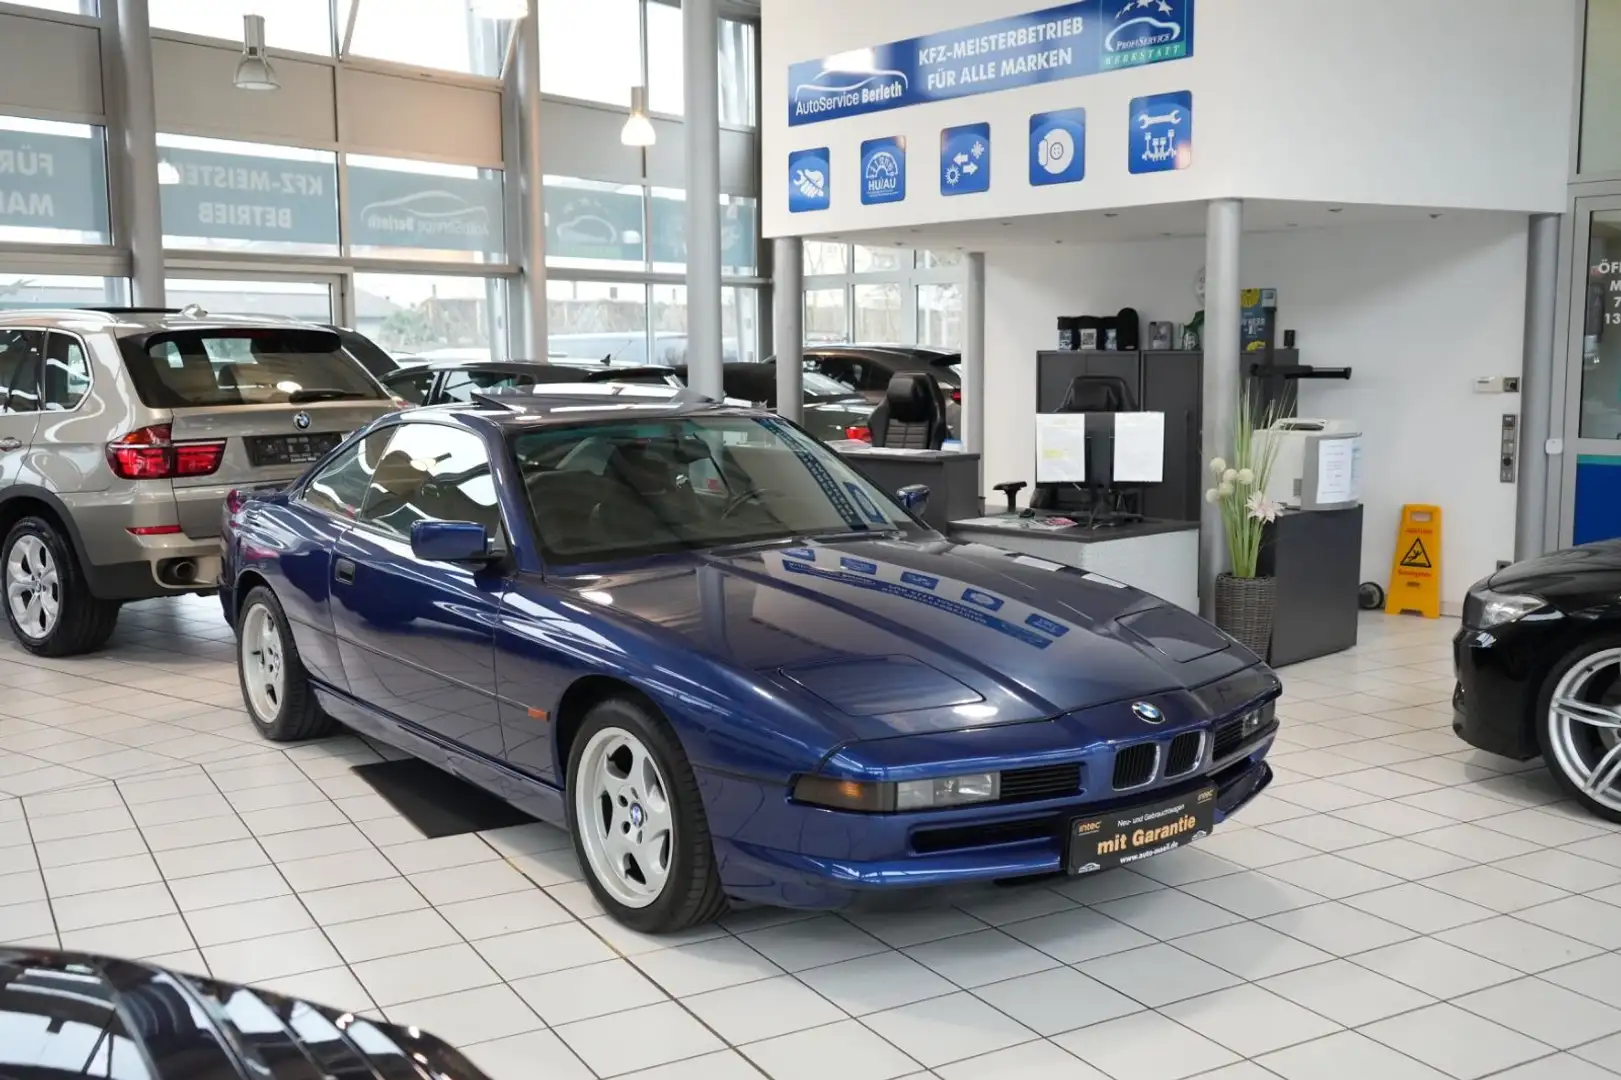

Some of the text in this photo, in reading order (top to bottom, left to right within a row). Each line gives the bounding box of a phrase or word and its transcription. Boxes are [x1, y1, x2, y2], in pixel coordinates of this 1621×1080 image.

[919, 16, 1084, 66] KFZ-MEISTERBETRIEB
[1105, 43, 1180, 66] WERKSTATT
[927, 48, 1073, 91] FÜR ALLE MARKEN
[796, 81, 902, 116] AutoService Berleth
[868, 176, 896, 191] HU/AU
[1097, 814, 1196, 855] mit Garantie
